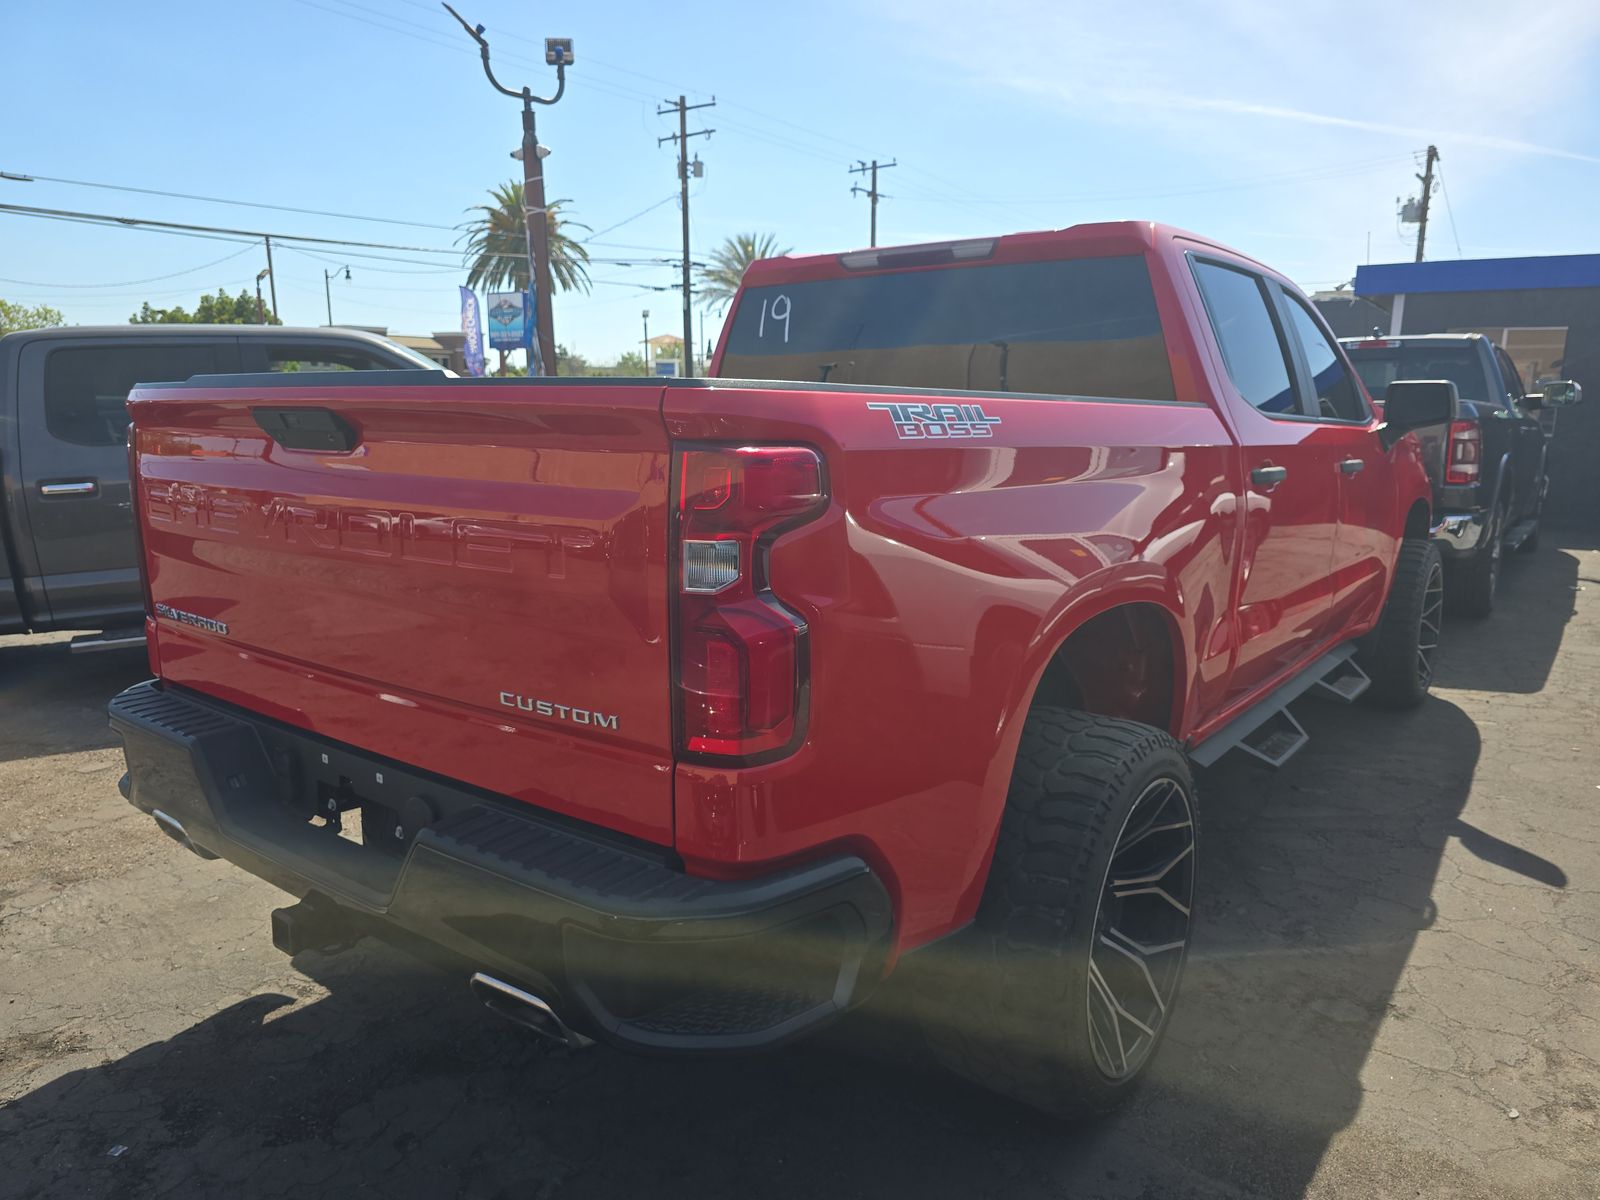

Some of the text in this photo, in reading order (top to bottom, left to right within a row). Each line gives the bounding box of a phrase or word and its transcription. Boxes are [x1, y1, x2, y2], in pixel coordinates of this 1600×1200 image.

[759, 294, 791, 343] 19
[866, 401, 1002, 423] TRAIL
[894, 422, 993, 440] BOSS
[155, 603, 228, 635] SILVERADO
[499, 691, 618, 729] CUSTOM
